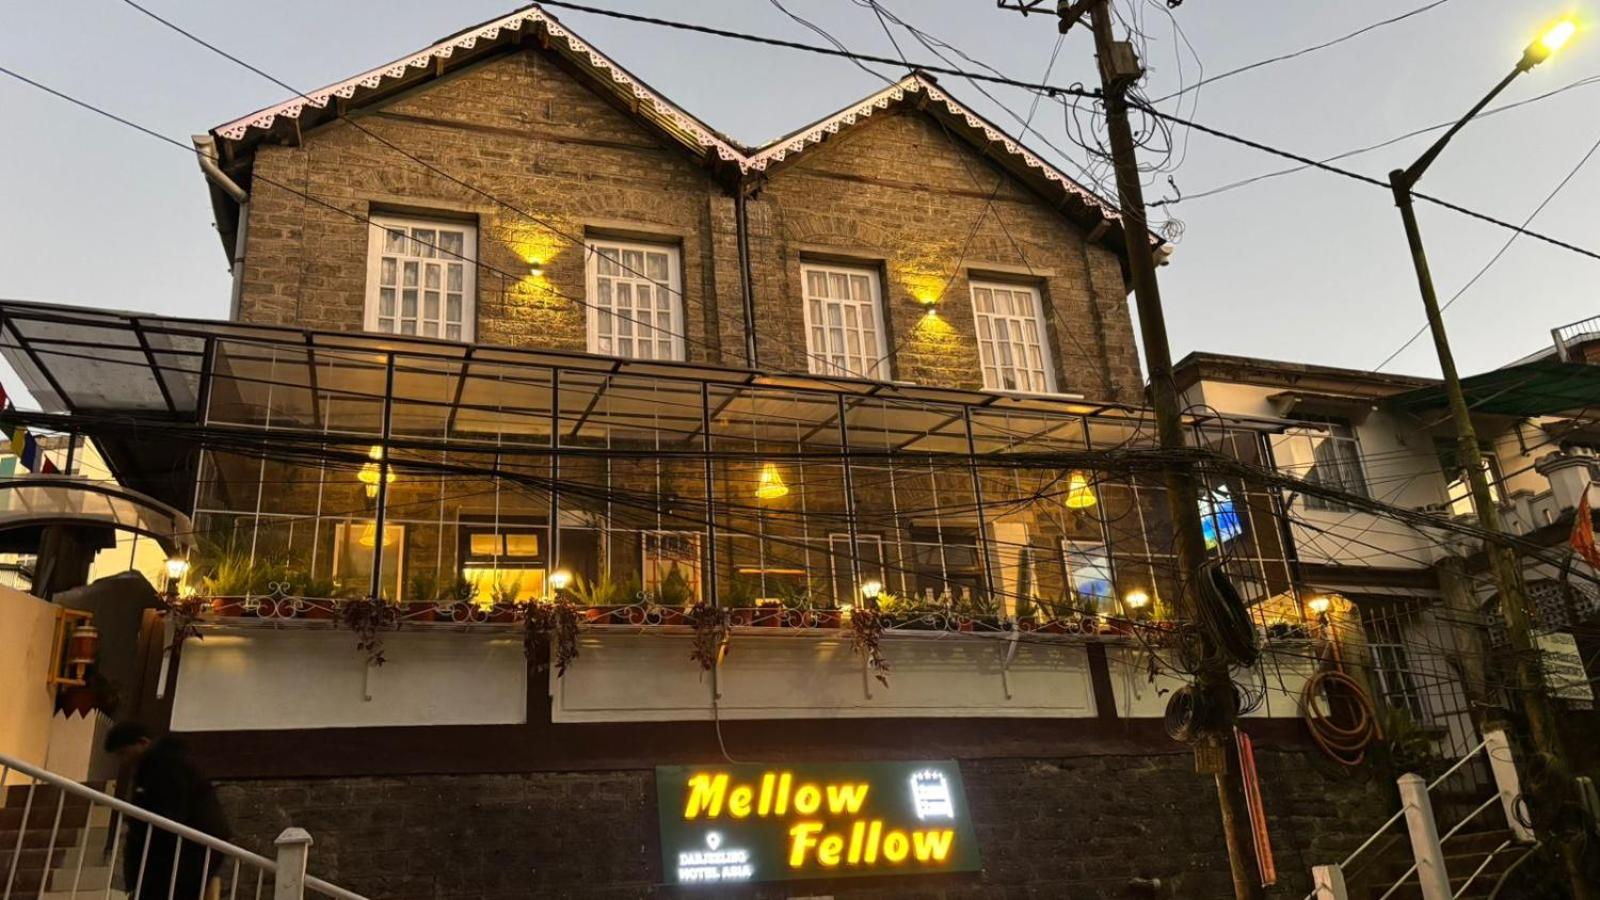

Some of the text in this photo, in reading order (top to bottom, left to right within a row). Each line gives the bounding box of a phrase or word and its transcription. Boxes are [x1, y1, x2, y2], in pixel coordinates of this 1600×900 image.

[685, 772, 869, 819] Mellow
[789, 820, 954, 867] Fellow
[679, 867, 720, 881] HOTEL
